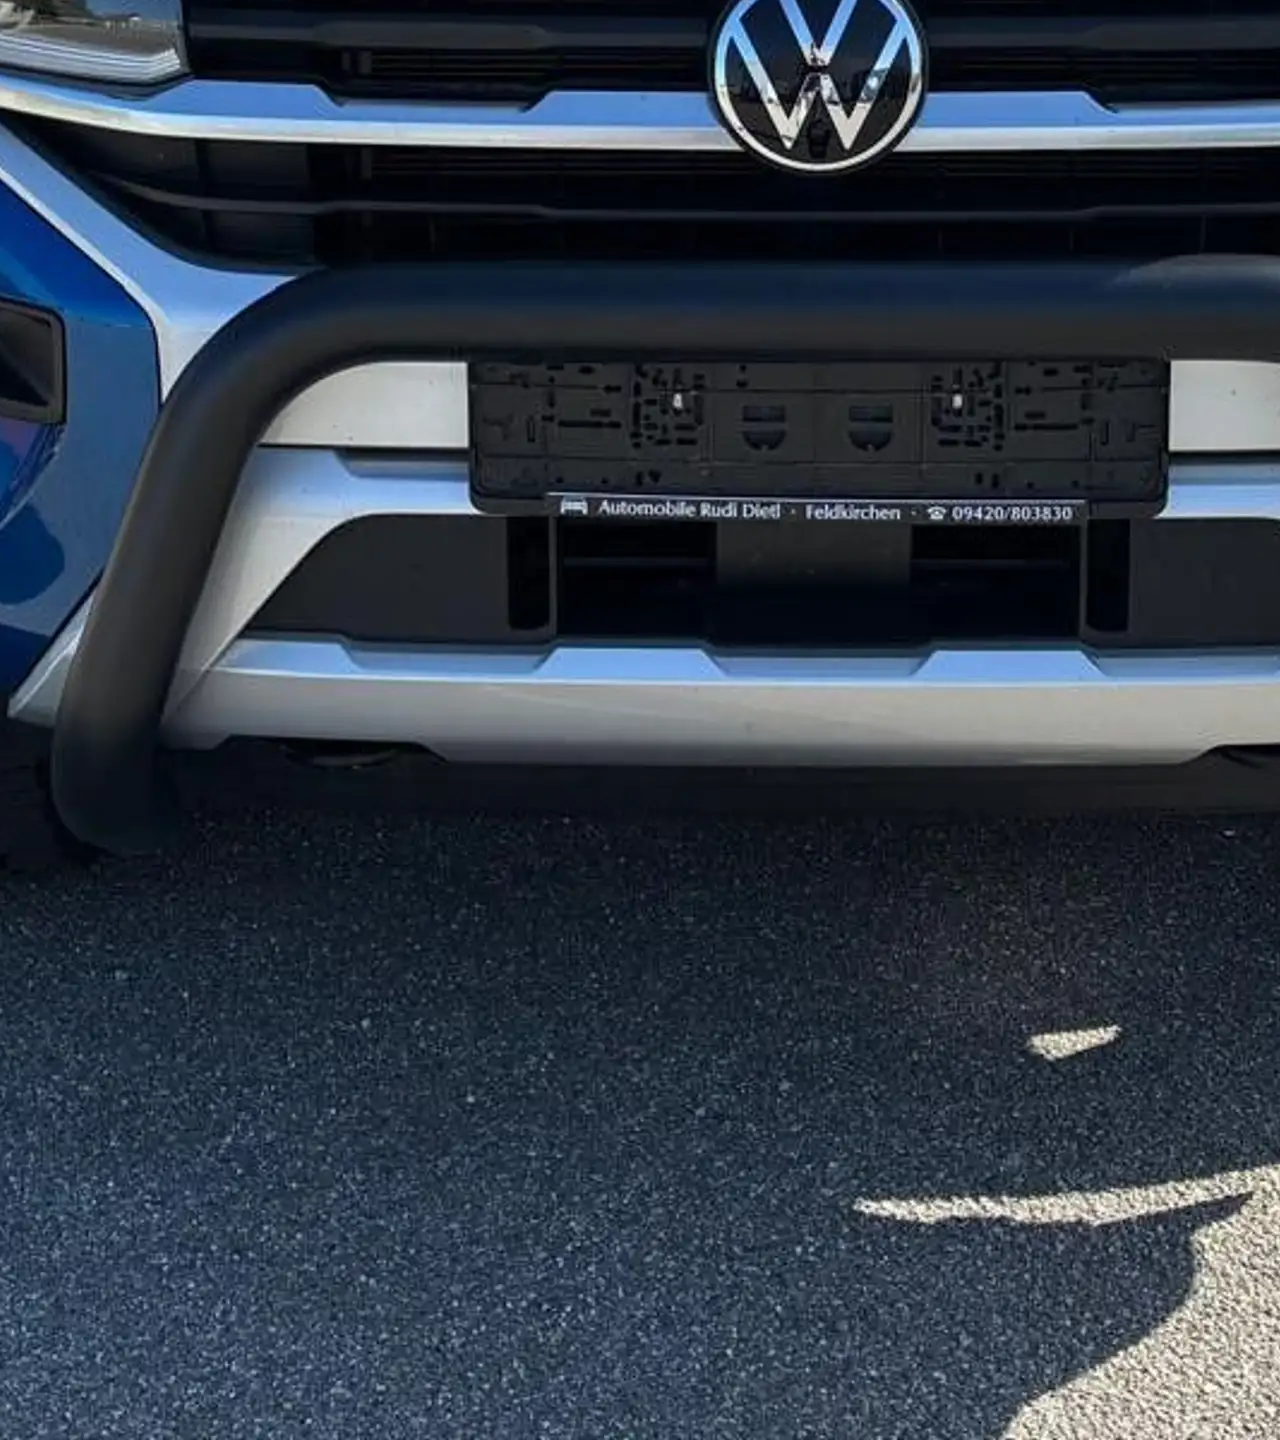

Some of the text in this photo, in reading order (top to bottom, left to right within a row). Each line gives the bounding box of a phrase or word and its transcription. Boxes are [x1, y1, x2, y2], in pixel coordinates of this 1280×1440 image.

[599, 499, 1072, 522] Automobile Rudi Dietl Feldkirchen 09420/803830
